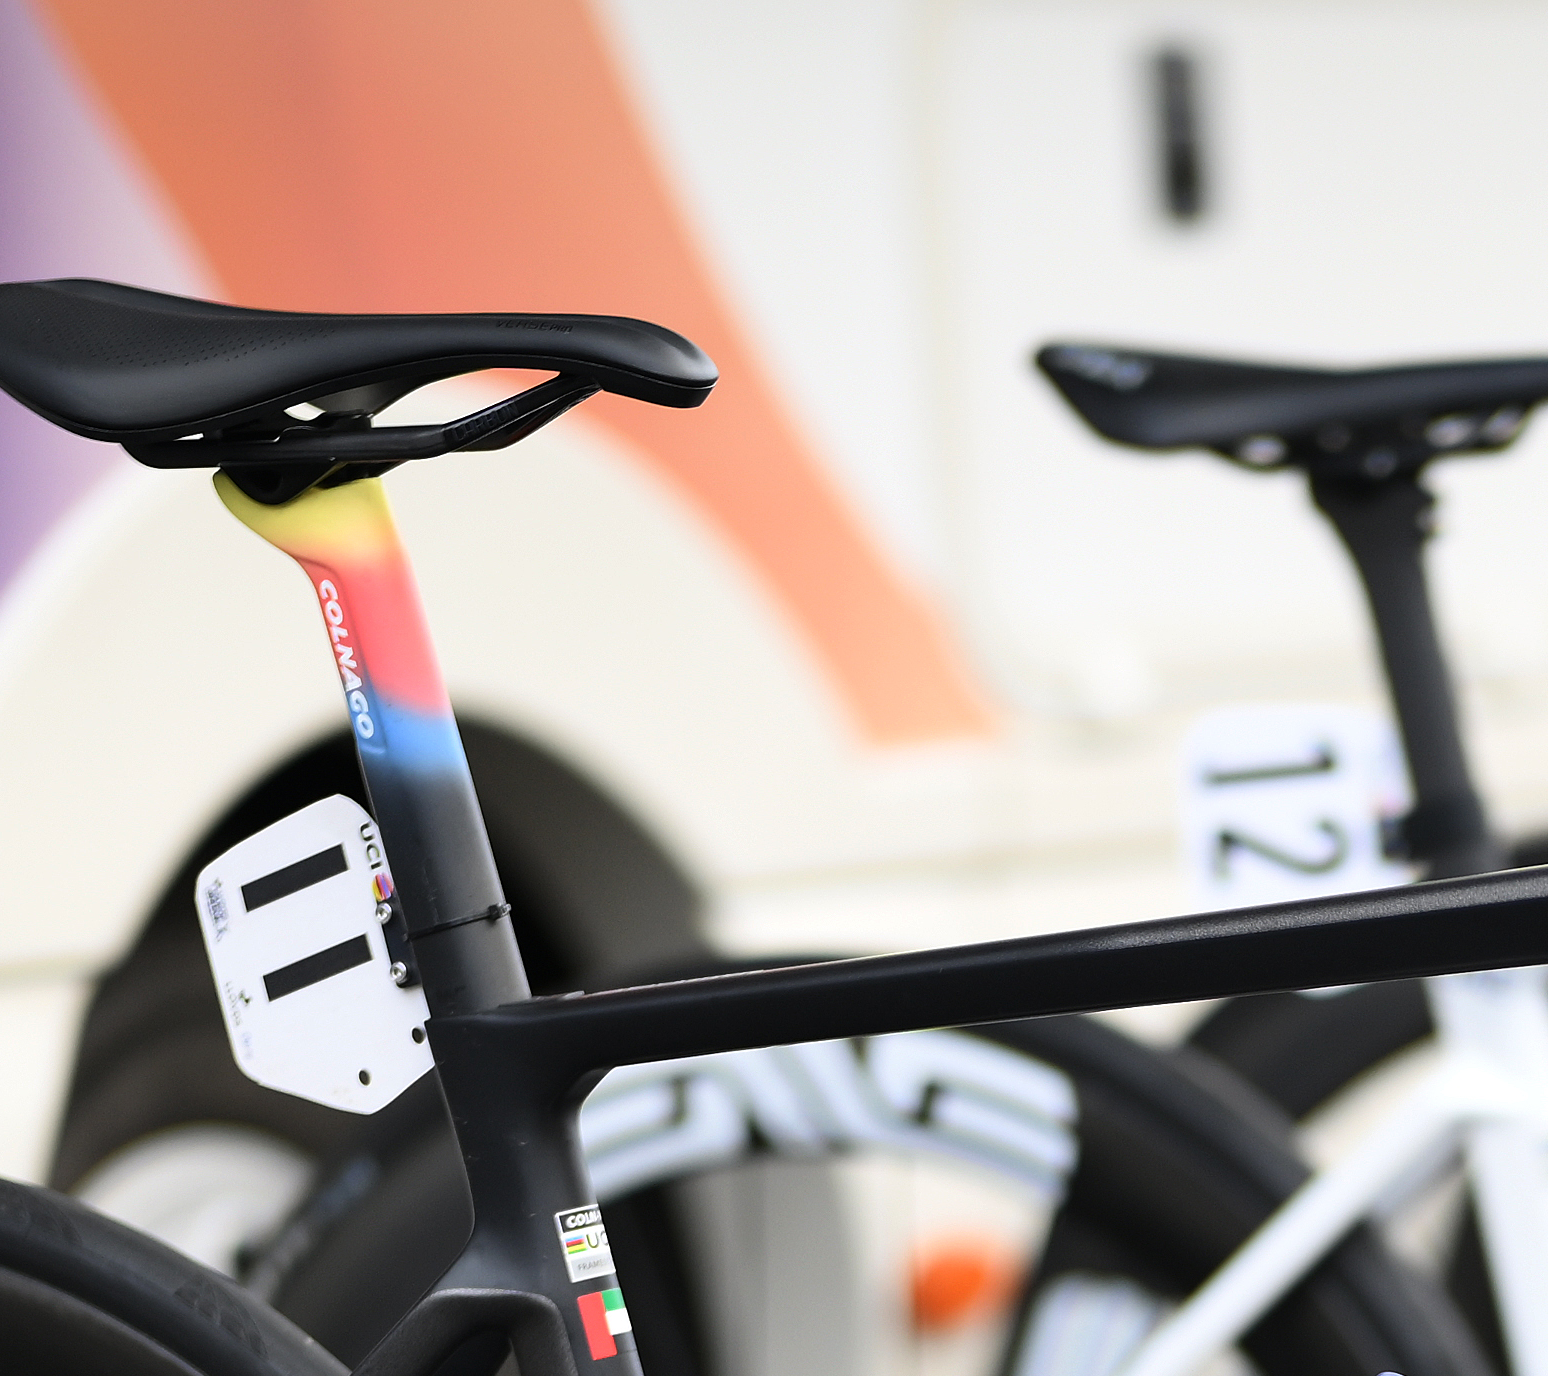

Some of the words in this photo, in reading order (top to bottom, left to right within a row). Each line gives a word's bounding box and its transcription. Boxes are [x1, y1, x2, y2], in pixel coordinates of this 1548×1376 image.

[319, 579, 374, 739] COLNAGO
[360, 821, 383, 870] UCI
[1202, 737, 1349, 882] 12
[241, 843, 374, 1003] 11
